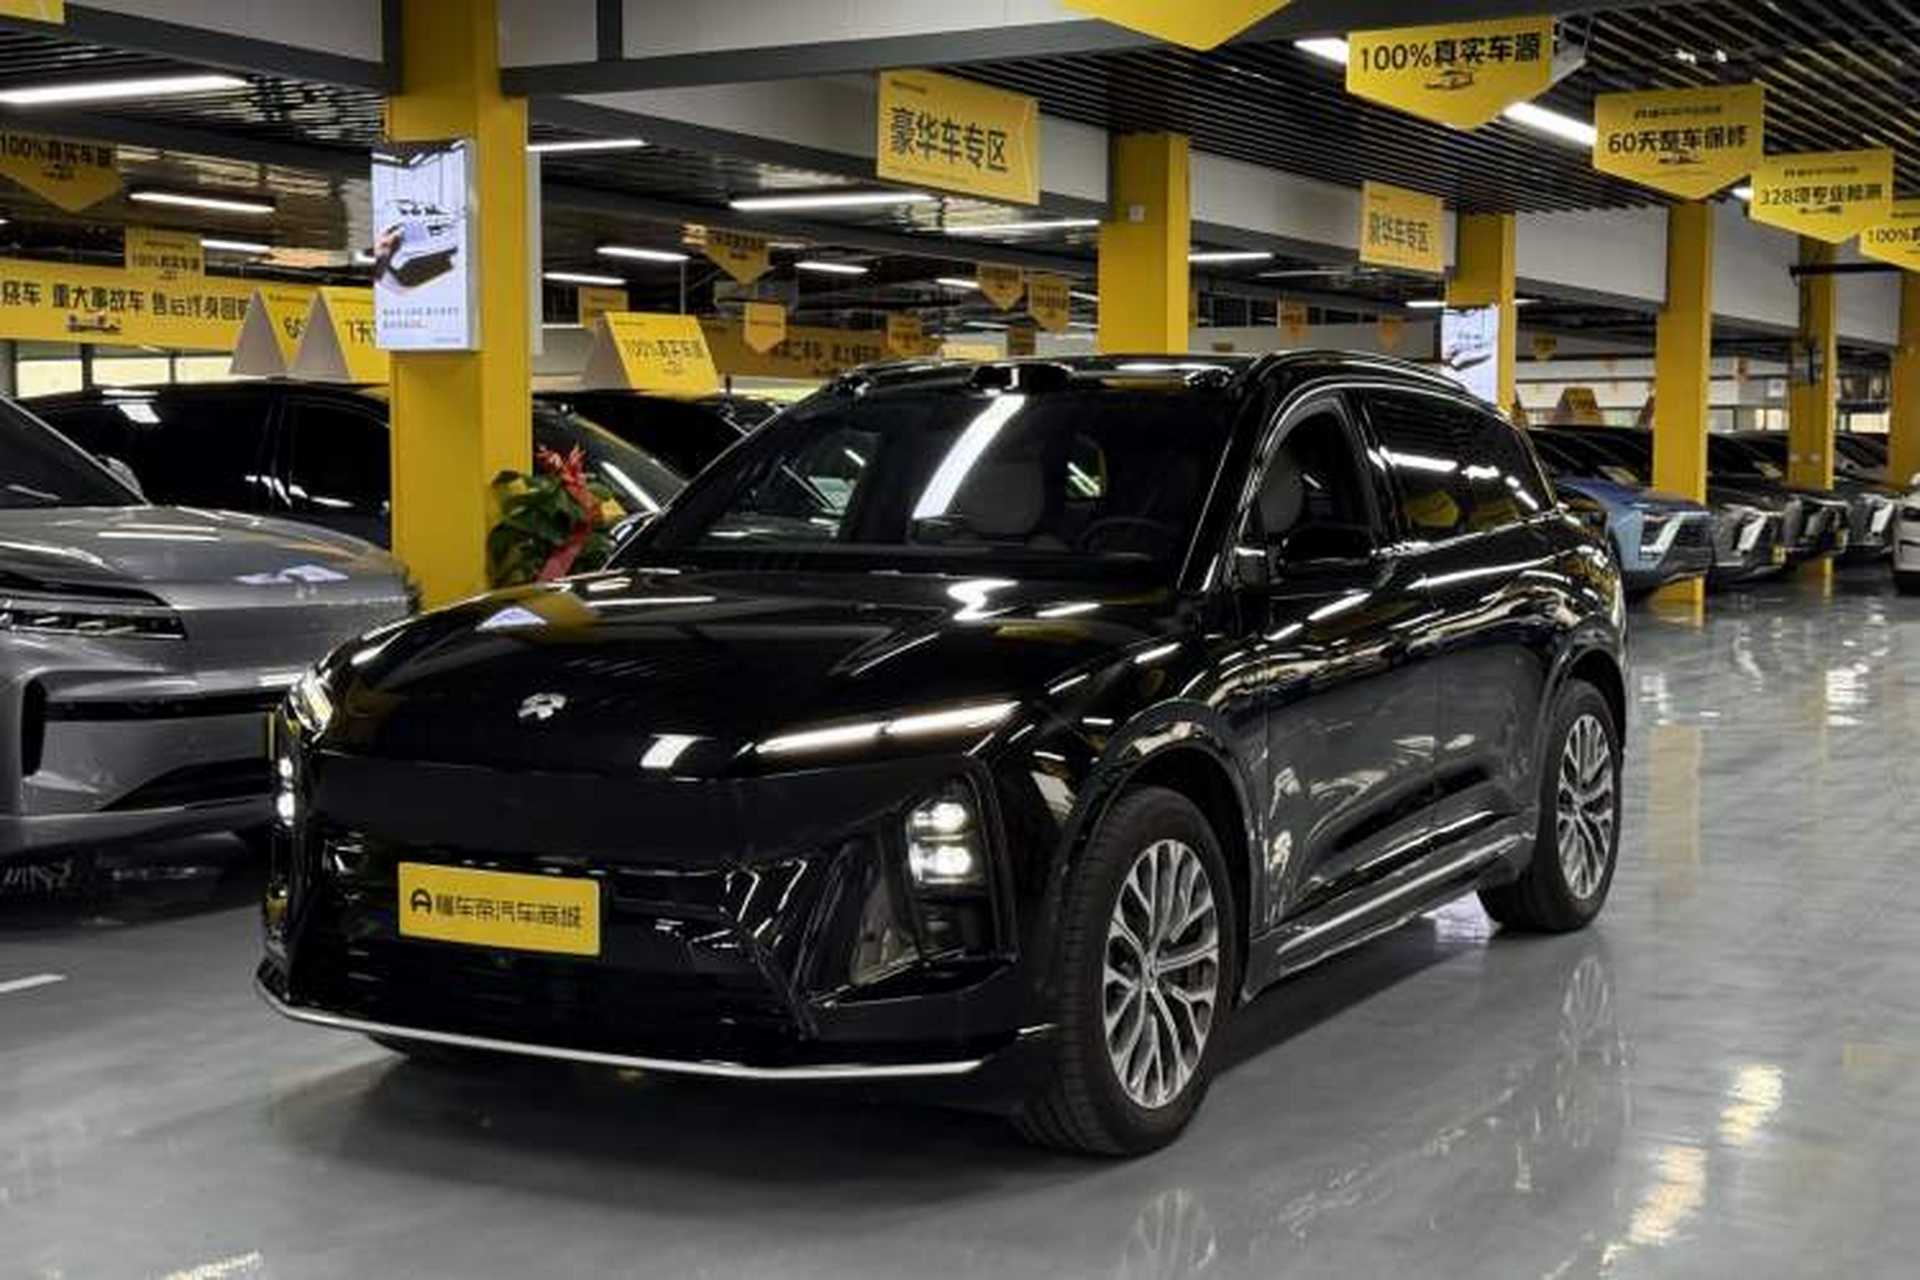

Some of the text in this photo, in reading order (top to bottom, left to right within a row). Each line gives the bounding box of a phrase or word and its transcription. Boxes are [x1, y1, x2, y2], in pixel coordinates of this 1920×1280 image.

[1361, 31, 1542, 72] 100%真实车源
[890, 106, 1008, 173] 豪华车专区
[1607, 124, 1751, 154] 60天整车保修
[1760, 183, 1883, 206] 328项专业检测
[52, 283, 145, 315] 重大事故车
[436, 892, 582, 929] 懂车帝汽车商城
